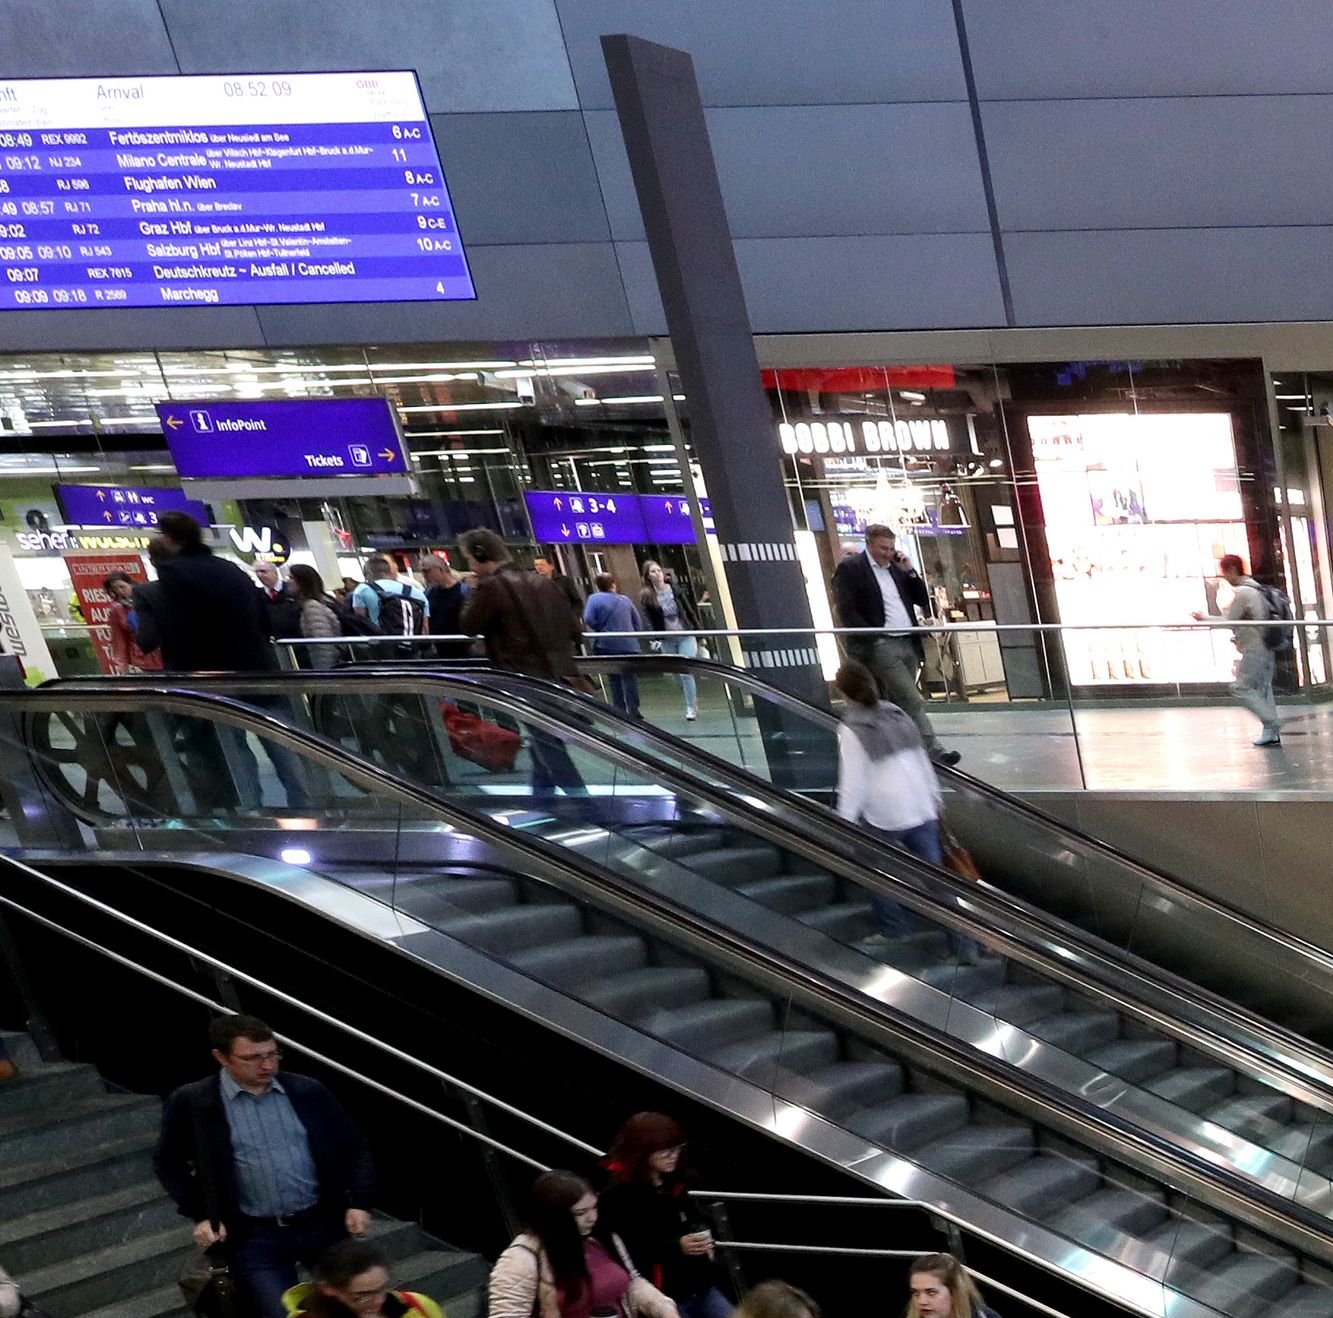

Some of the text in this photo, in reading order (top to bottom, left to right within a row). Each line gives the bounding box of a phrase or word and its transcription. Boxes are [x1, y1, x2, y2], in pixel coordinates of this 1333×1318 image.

[97, 84, 144, 100] Arrival
[41, 133, 64, 145] REX
[392, 125, 402, 139] 6
[6, 155, 42, 170] 09:12
[116, 153, 156, 168] Milano
[157, 151, 207, 168] Centrale
[392, 148, 408, 162] 11
[124, 176, 182, 193] Flughafen
[183, 175, 217, 190] Wien
[405, 171, 415, 184] 8
[22, 201, 55, 215] 08:57
[131, 199, 167, 213] Praha
[410, 193, 419, 206] 7
[139, 221, 170, 235] Graz
[170, 220, 192, 235] Hbf
[417, 215, 427, 229] 9
[37, 245, 72, 259] 09:10
[147, 243, 199, 259] Salzburg
[199, 242, 222, 256] Hbf
[416, 237, 433, 251] 10
[6, 267, 39, 282] 09:07
[153, 264, 238, 279] Deutschkreutz
[250, 263, 289, 277] Ausfall
[299, 262, 356, 276] Cancelled
[15, 289, 49, 303] 09:09
[53, 289, 87, 303] 09:18
[160, 286, 220, 303] Marchegg
[436, 280, 445, 294] 4
[216, 419, 267, 432] InfoPoint
[779, 419, 950, 454] BOBBI BROWN
[304, 454, 344, 467] Tickets
[588, 498, 617, 513] 3-4
